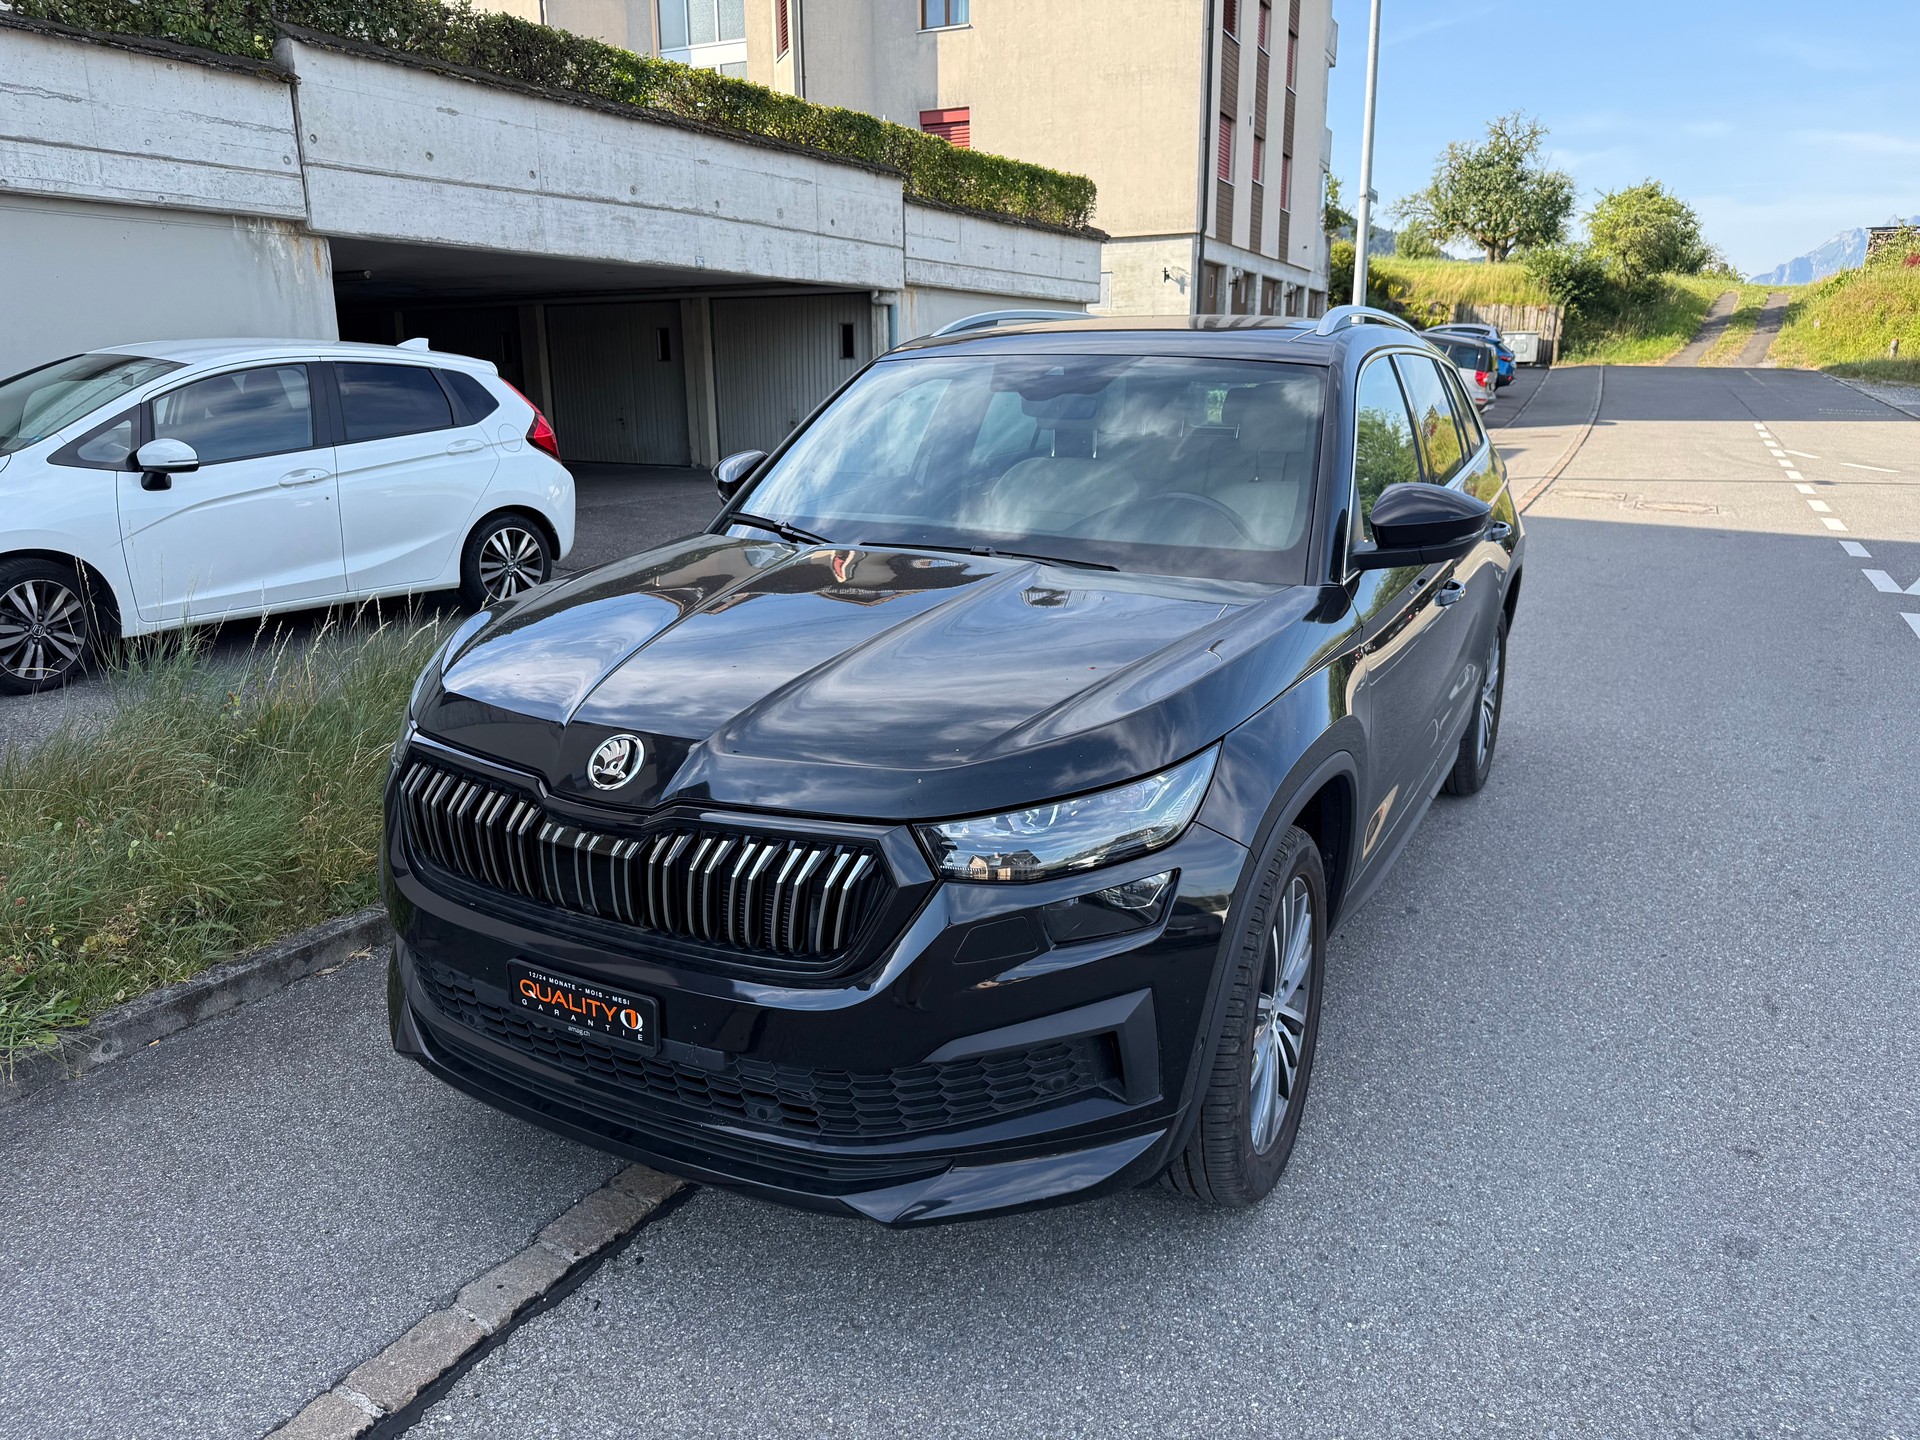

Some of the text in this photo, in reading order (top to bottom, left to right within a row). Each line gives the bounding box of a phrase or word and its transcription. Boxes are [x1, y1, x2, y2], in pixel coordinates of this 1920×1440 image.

[528, 971, 546, 981] 12/24
[549, 977, 576, 991] MONATE
[585, 988, 603, 998] MOIS
[612, 995, 630, 1006] MESI
[521, 998, 643, 1042] GARANTIE
[567, 1025, 591, 1037] amag.ch
